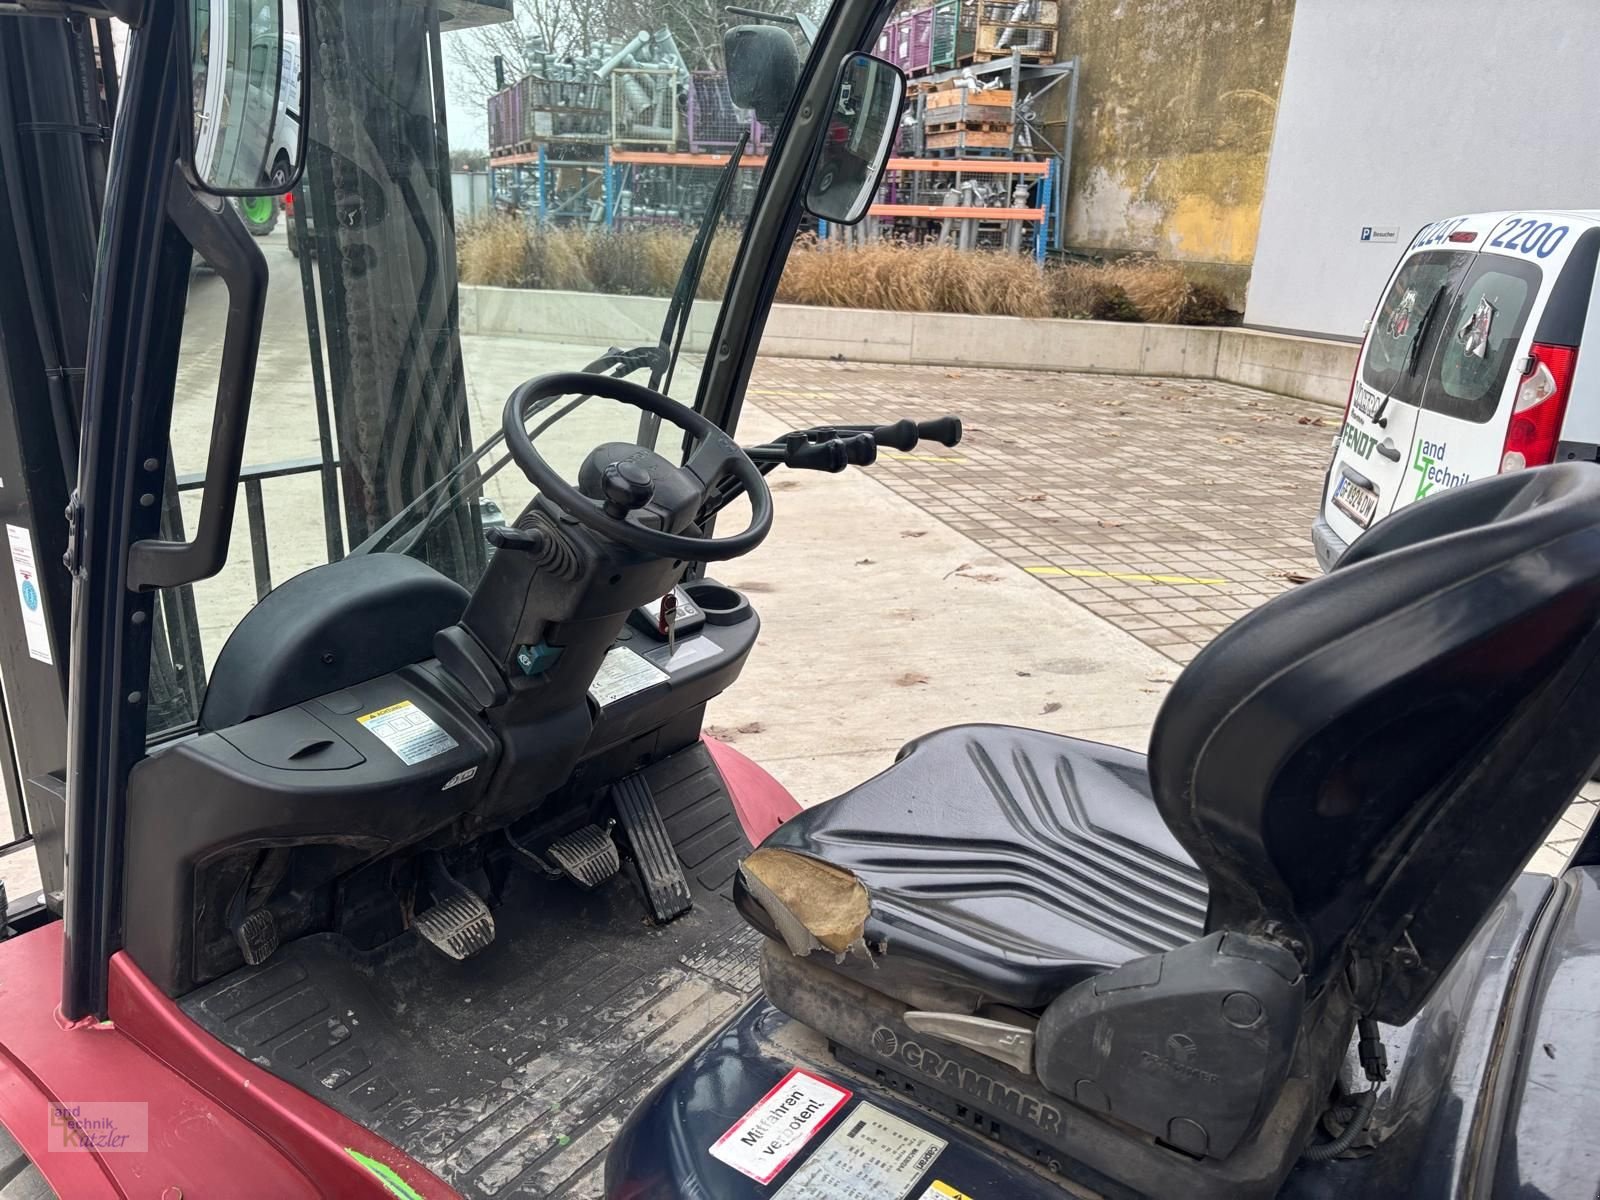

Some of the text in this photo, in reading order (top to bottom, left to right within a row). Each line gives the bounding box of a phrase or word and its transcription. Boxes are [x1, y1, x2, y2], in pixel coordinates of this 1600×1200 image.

[1490, 218, 1570, 259] 2200
[1342, 422, 1378, 460] FENDT
[902, 1041, 1061, 1135] GRAMMER
[741, 1090, 804, 1147] Mitfahren
